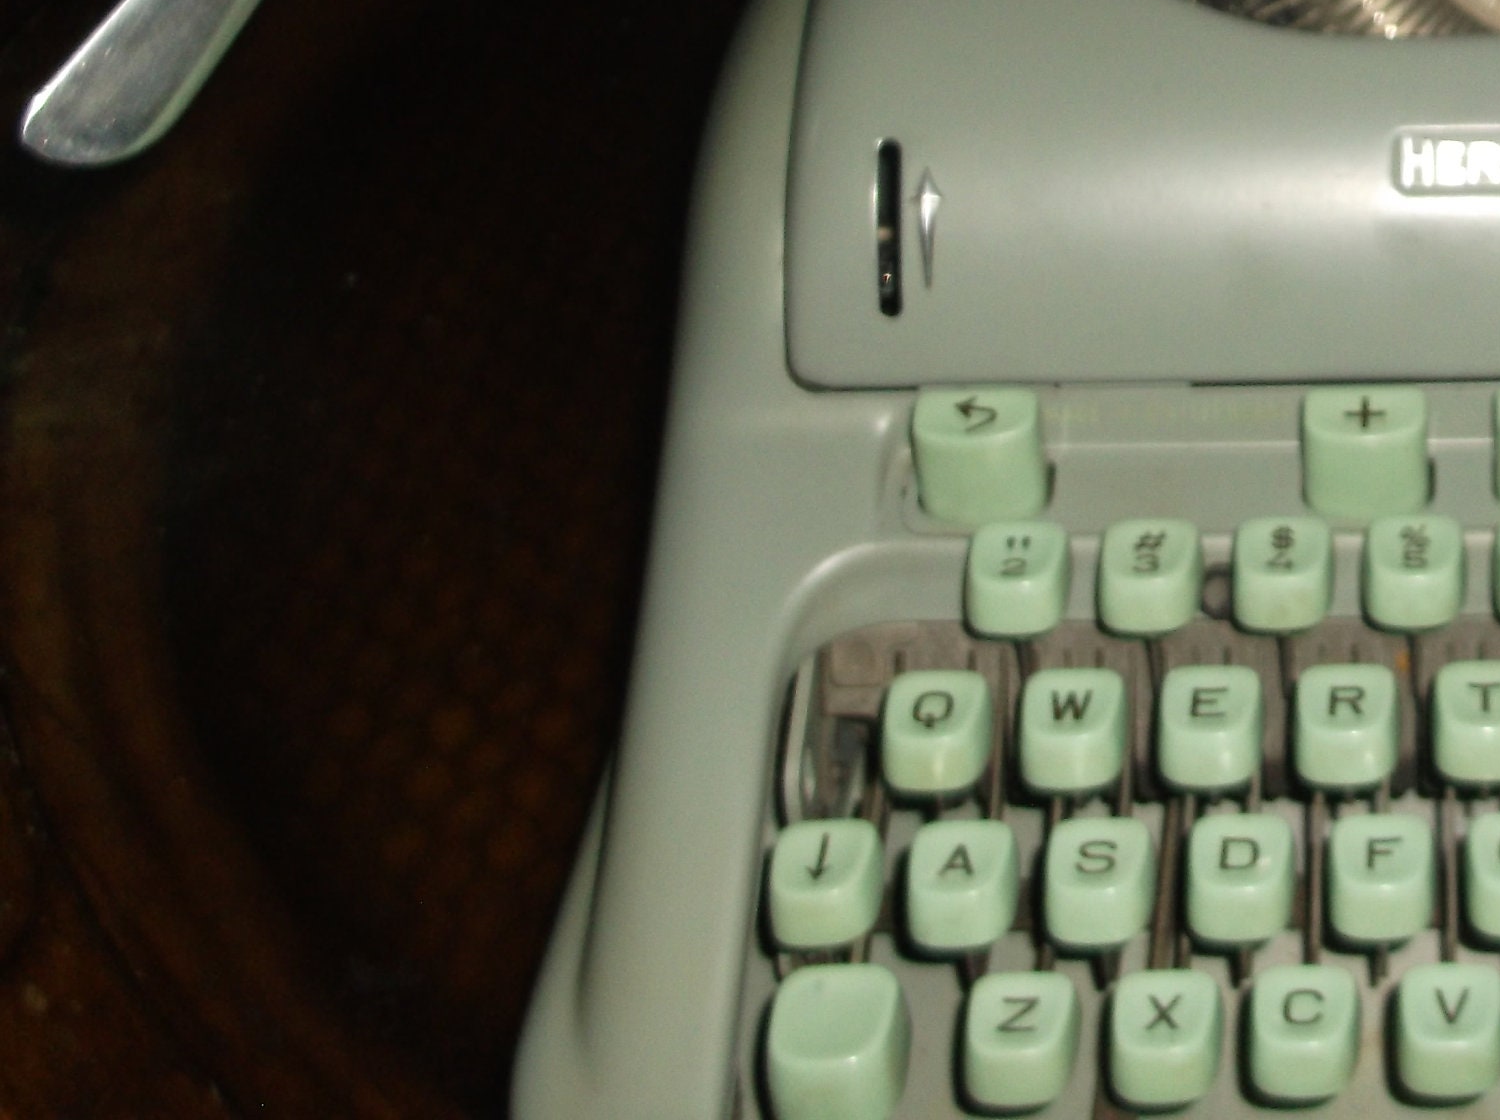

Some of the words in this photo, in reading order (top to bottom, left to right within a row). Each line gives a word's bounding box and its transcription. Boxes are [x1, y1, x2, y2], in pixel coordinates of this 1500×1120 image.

[911, 691, 954, 731] Q
[1052, 692, 1091, 723] W
[1189, 688, 1227, 720] E
[1328, 687, 1365, 717] R
[1469, 683, 1500, 714] T
[939, 845, 975, 878] A
[1074, 840, 1117, 880] S
[1218, 838, 1260, 873] D
[1365, 838, 1401, 871] F
[995, 997, 1039, 1039] Z
[1146, 996, 1180, 1032] X
[1281, 989, 1324, 1031] C
[1436, 989, 1468, 1029] V
